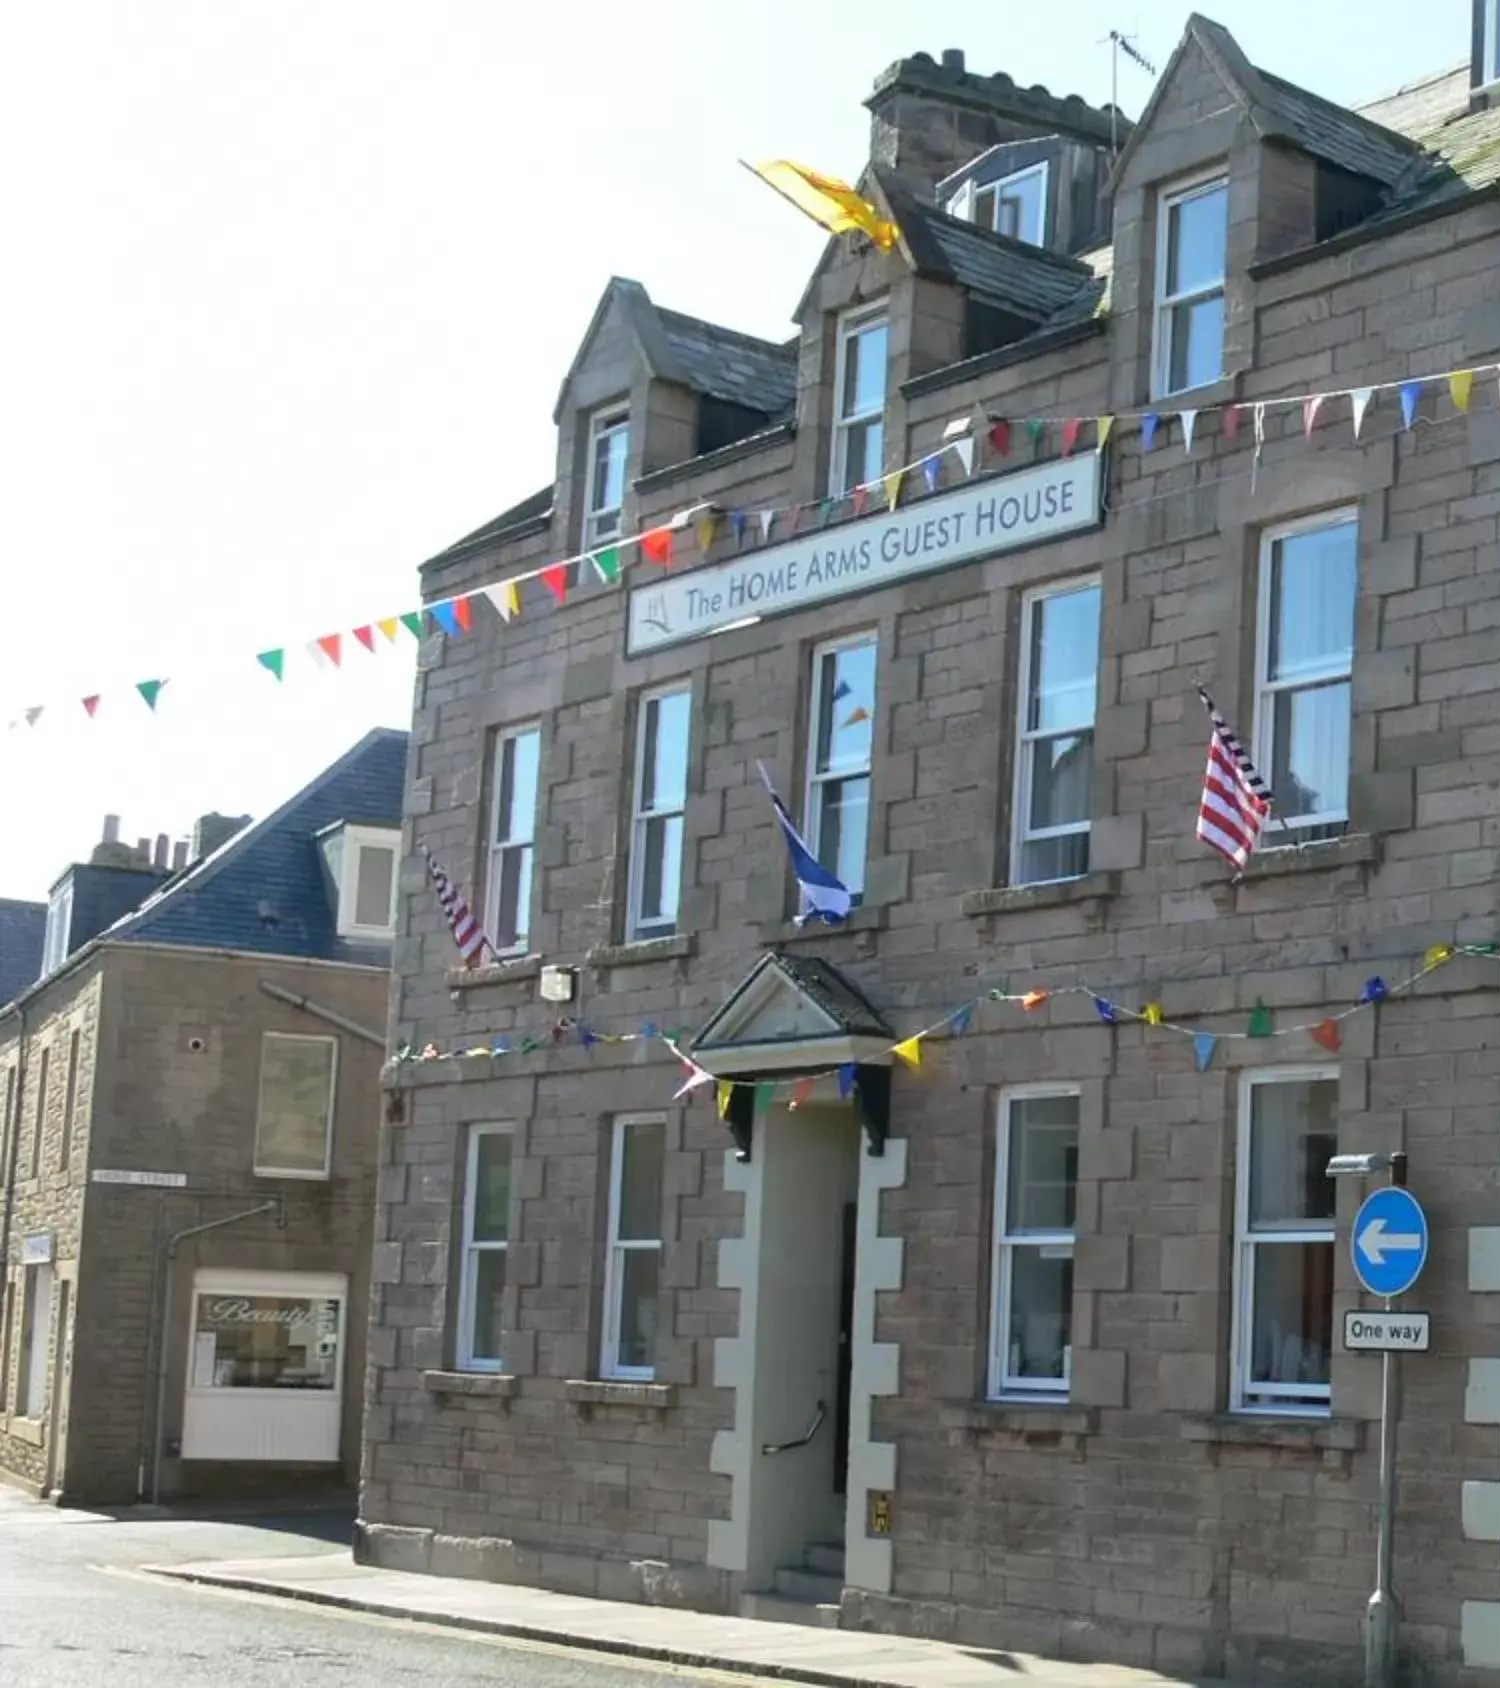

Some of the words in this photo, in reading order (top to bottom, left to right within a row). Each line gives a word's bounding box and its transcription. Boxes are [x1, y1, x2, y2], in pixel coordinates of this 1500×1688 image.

[686, 587, 722, 621] The
[729, 561, 798, 609] HOME
[805, 543, 871, 588] ARMS
[880, 512, 966, 564] GUEST
[975, 480, 1074, 537] HOUSE
[207, 1299, 313, 1329] Beauty
[1351, 1320, 1383, 1338] One
[1388, 1325, 1423, 1343] way
